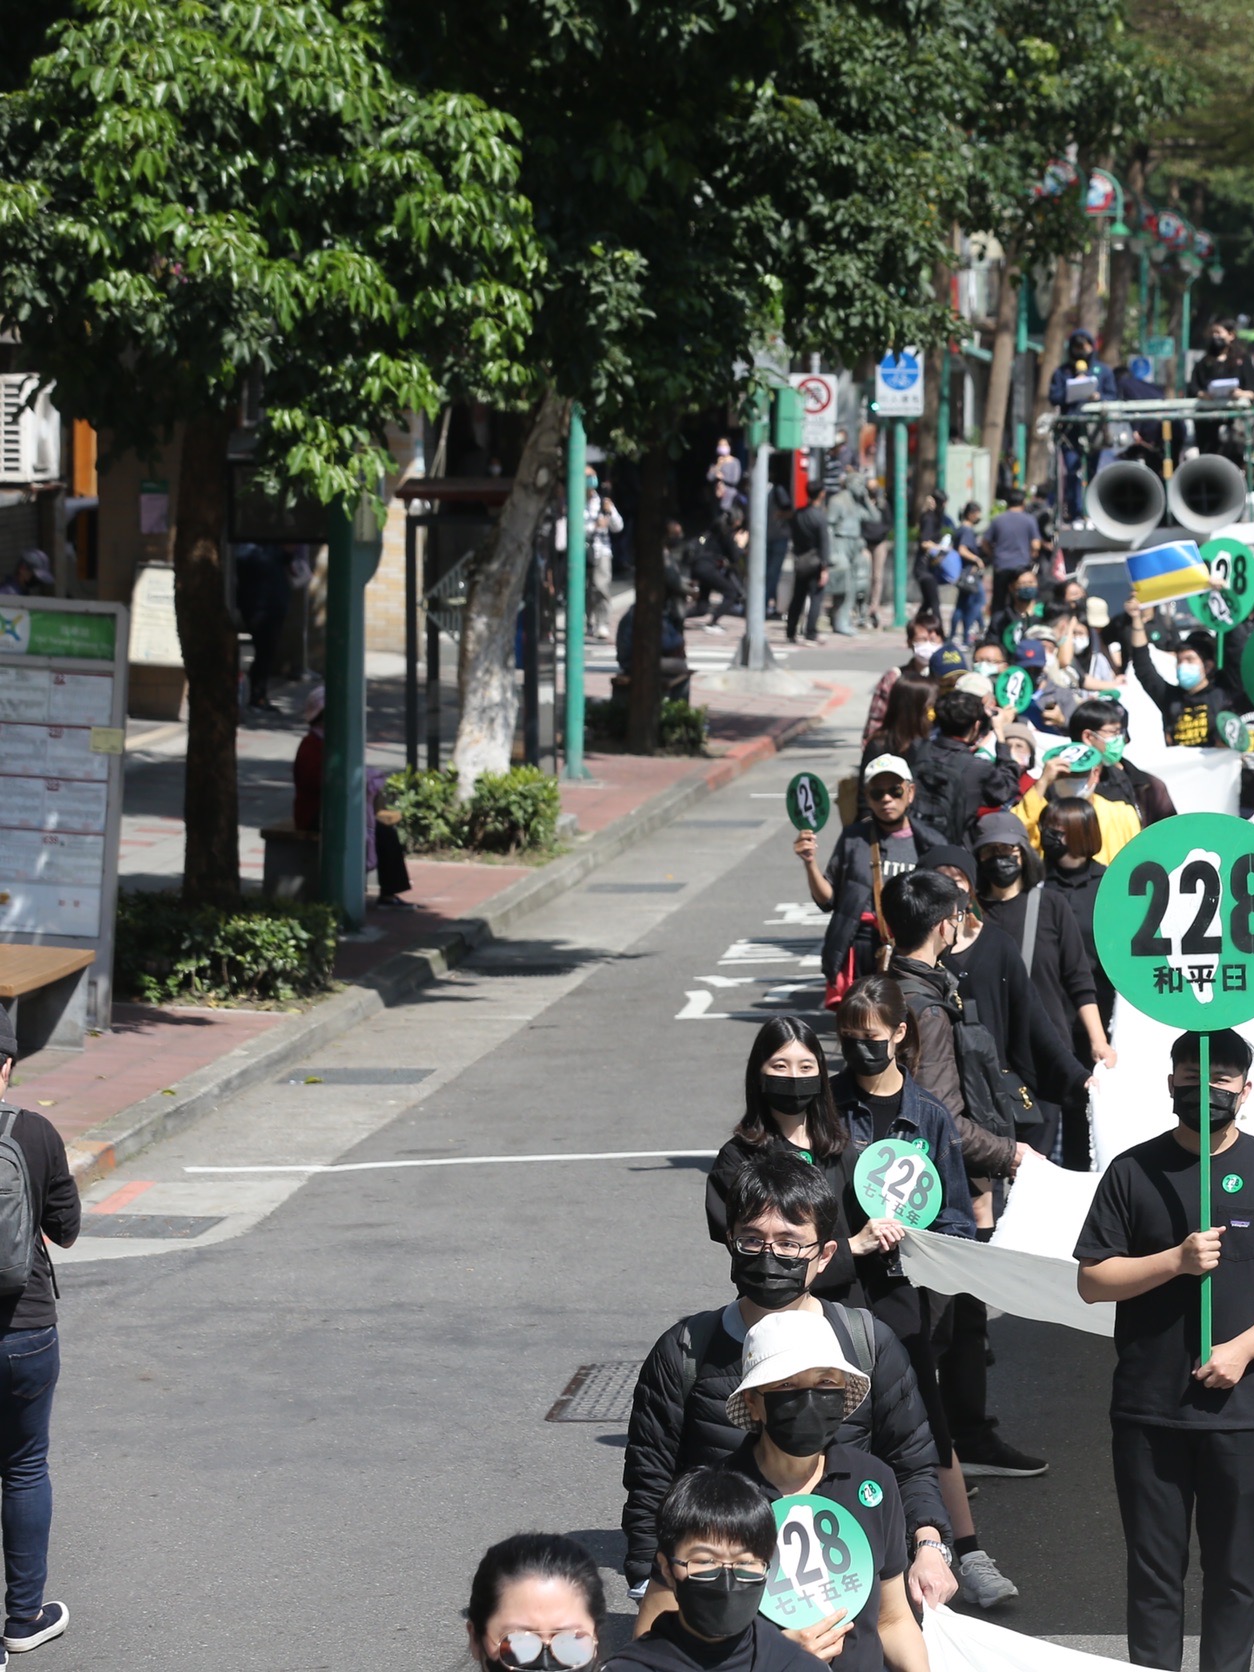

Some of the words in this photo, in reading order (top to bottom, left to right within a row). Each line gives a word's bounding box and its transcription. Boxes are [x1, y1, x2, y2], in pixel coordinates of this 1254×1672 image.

[1203, 555, 1247, 596] 28
[1153, 964, 1247, 994] 和平日
[867, 1146, 934, 1211] 228
[863, 1183, 921, 1225] 七十五年
[775, 1573, 862, 1615] 七十五年
